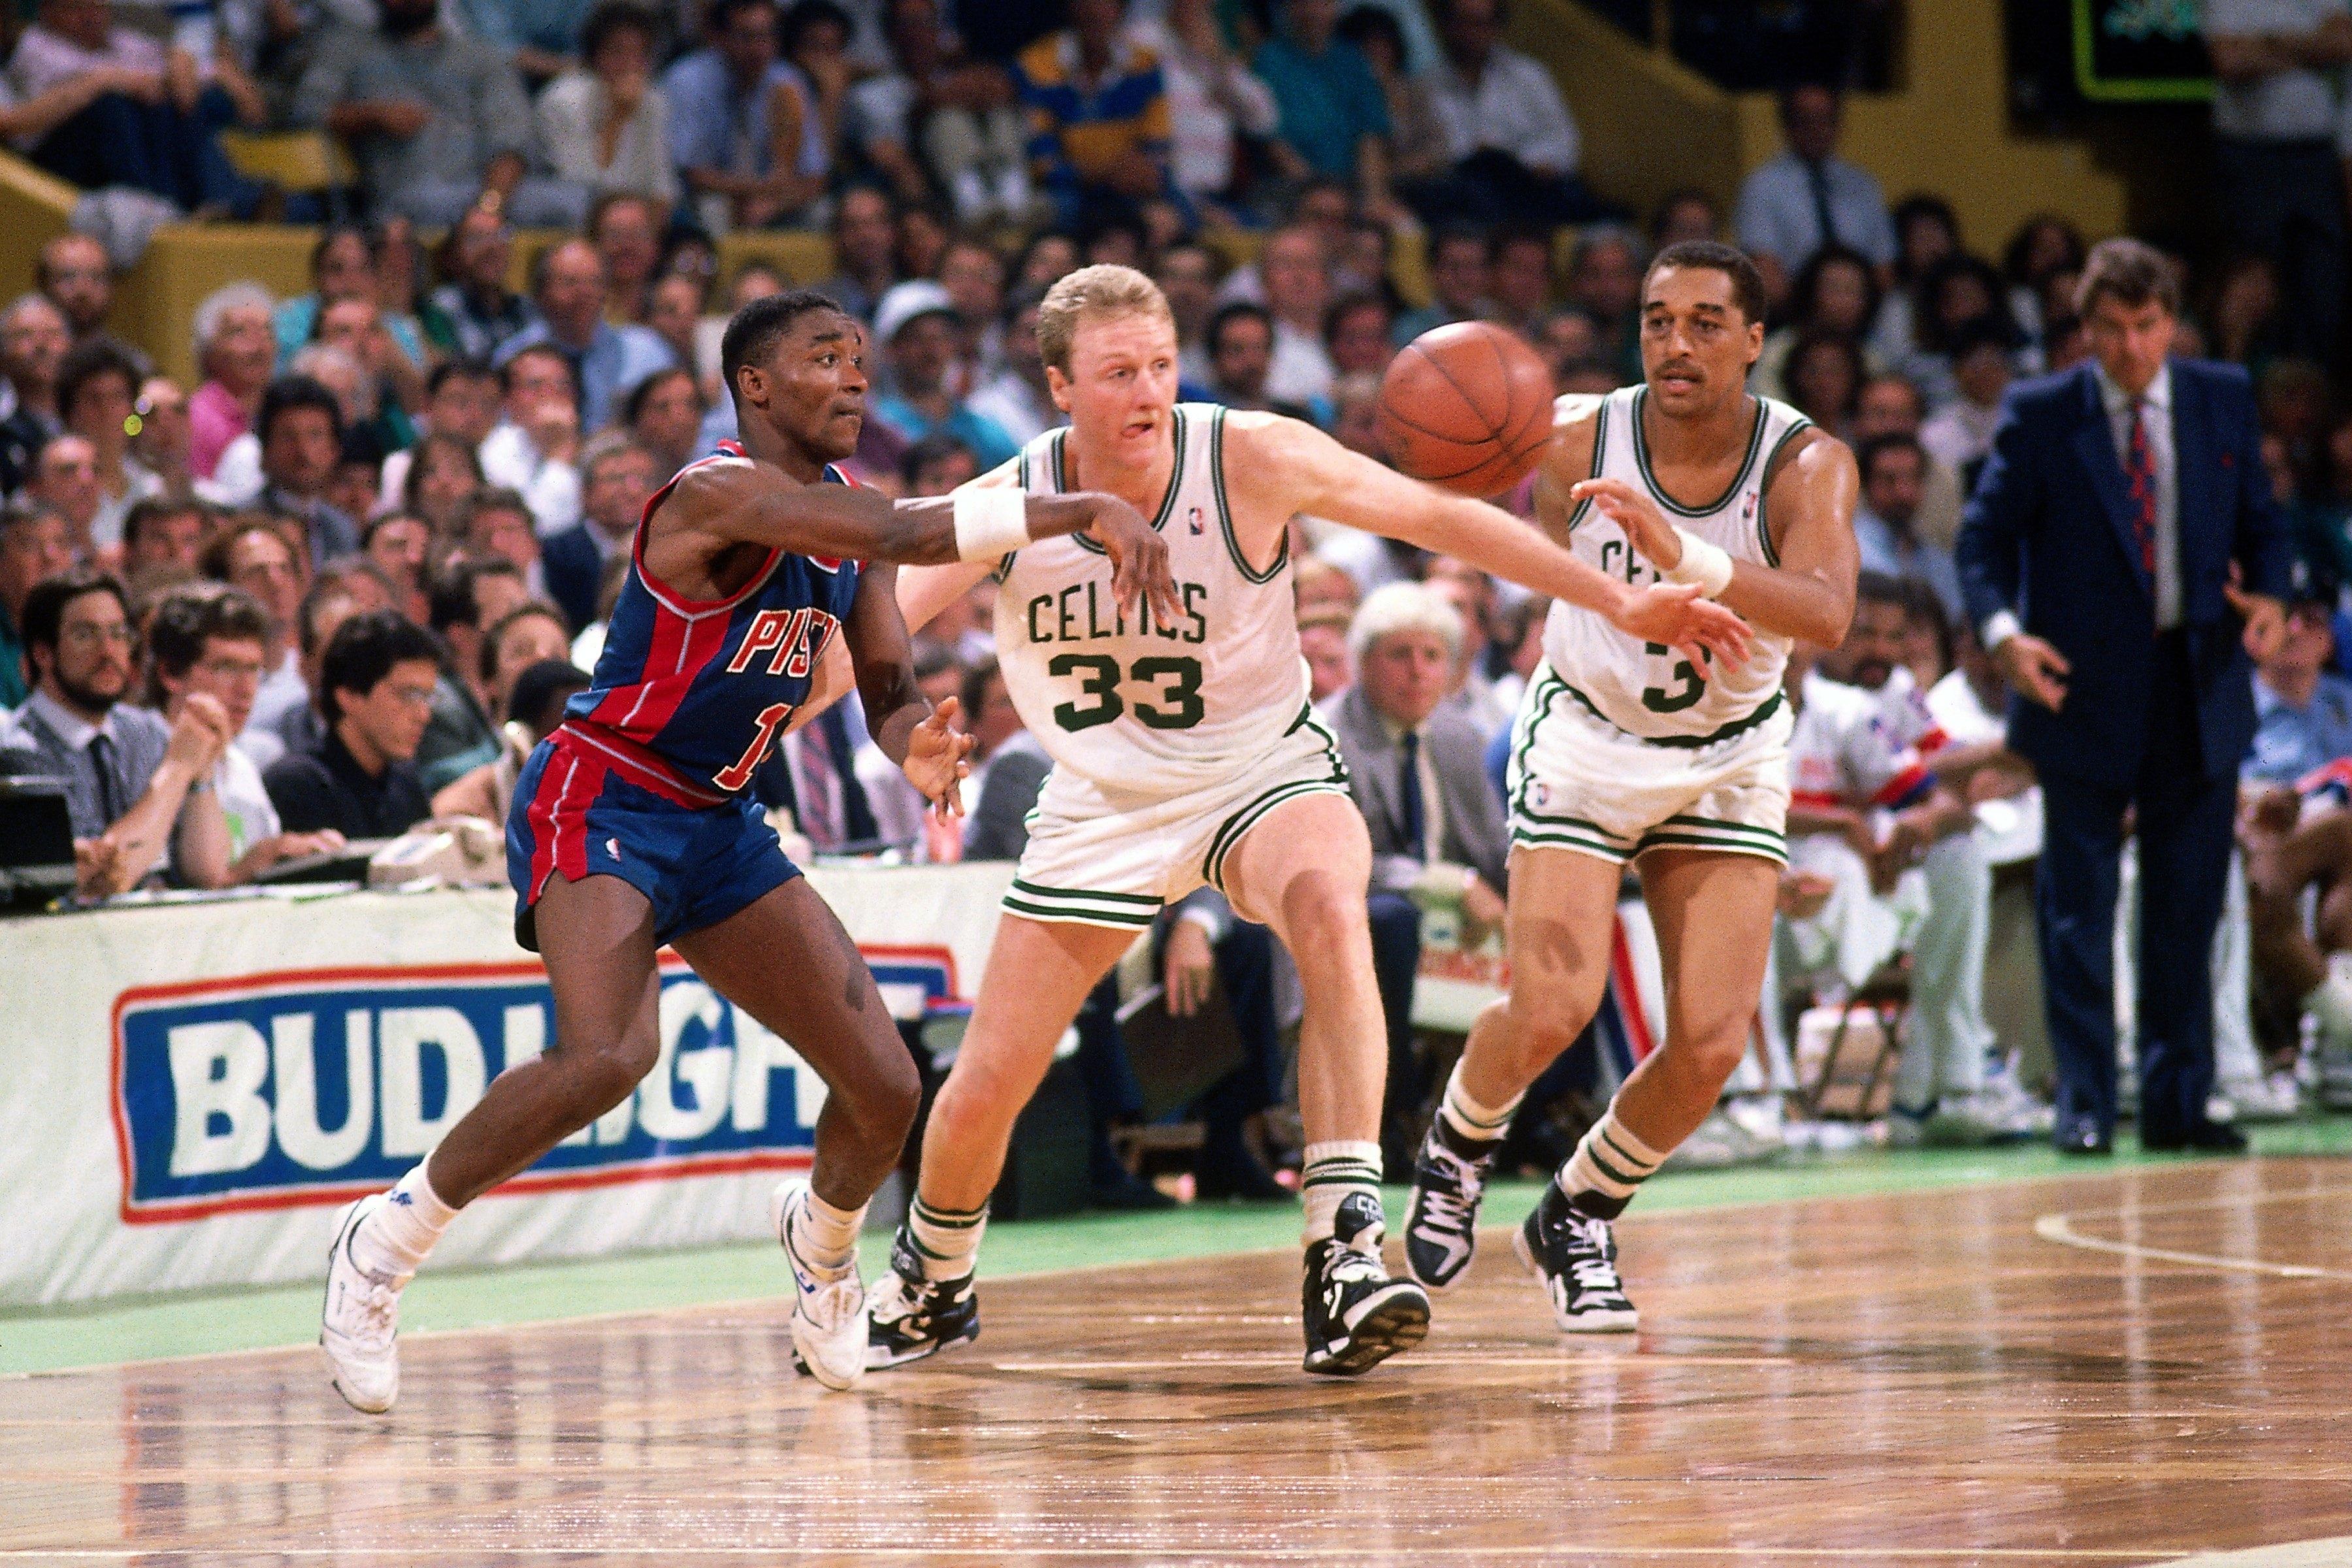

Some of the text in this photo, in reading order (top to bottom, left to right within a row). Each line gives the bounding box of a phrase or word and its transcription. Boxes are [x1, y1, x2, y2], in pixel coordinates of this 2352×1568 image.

[1049, 654, 1205, 732] 33
[712, 702, 792, 791] 1
[169, 1007, 488, 1177] BUD
